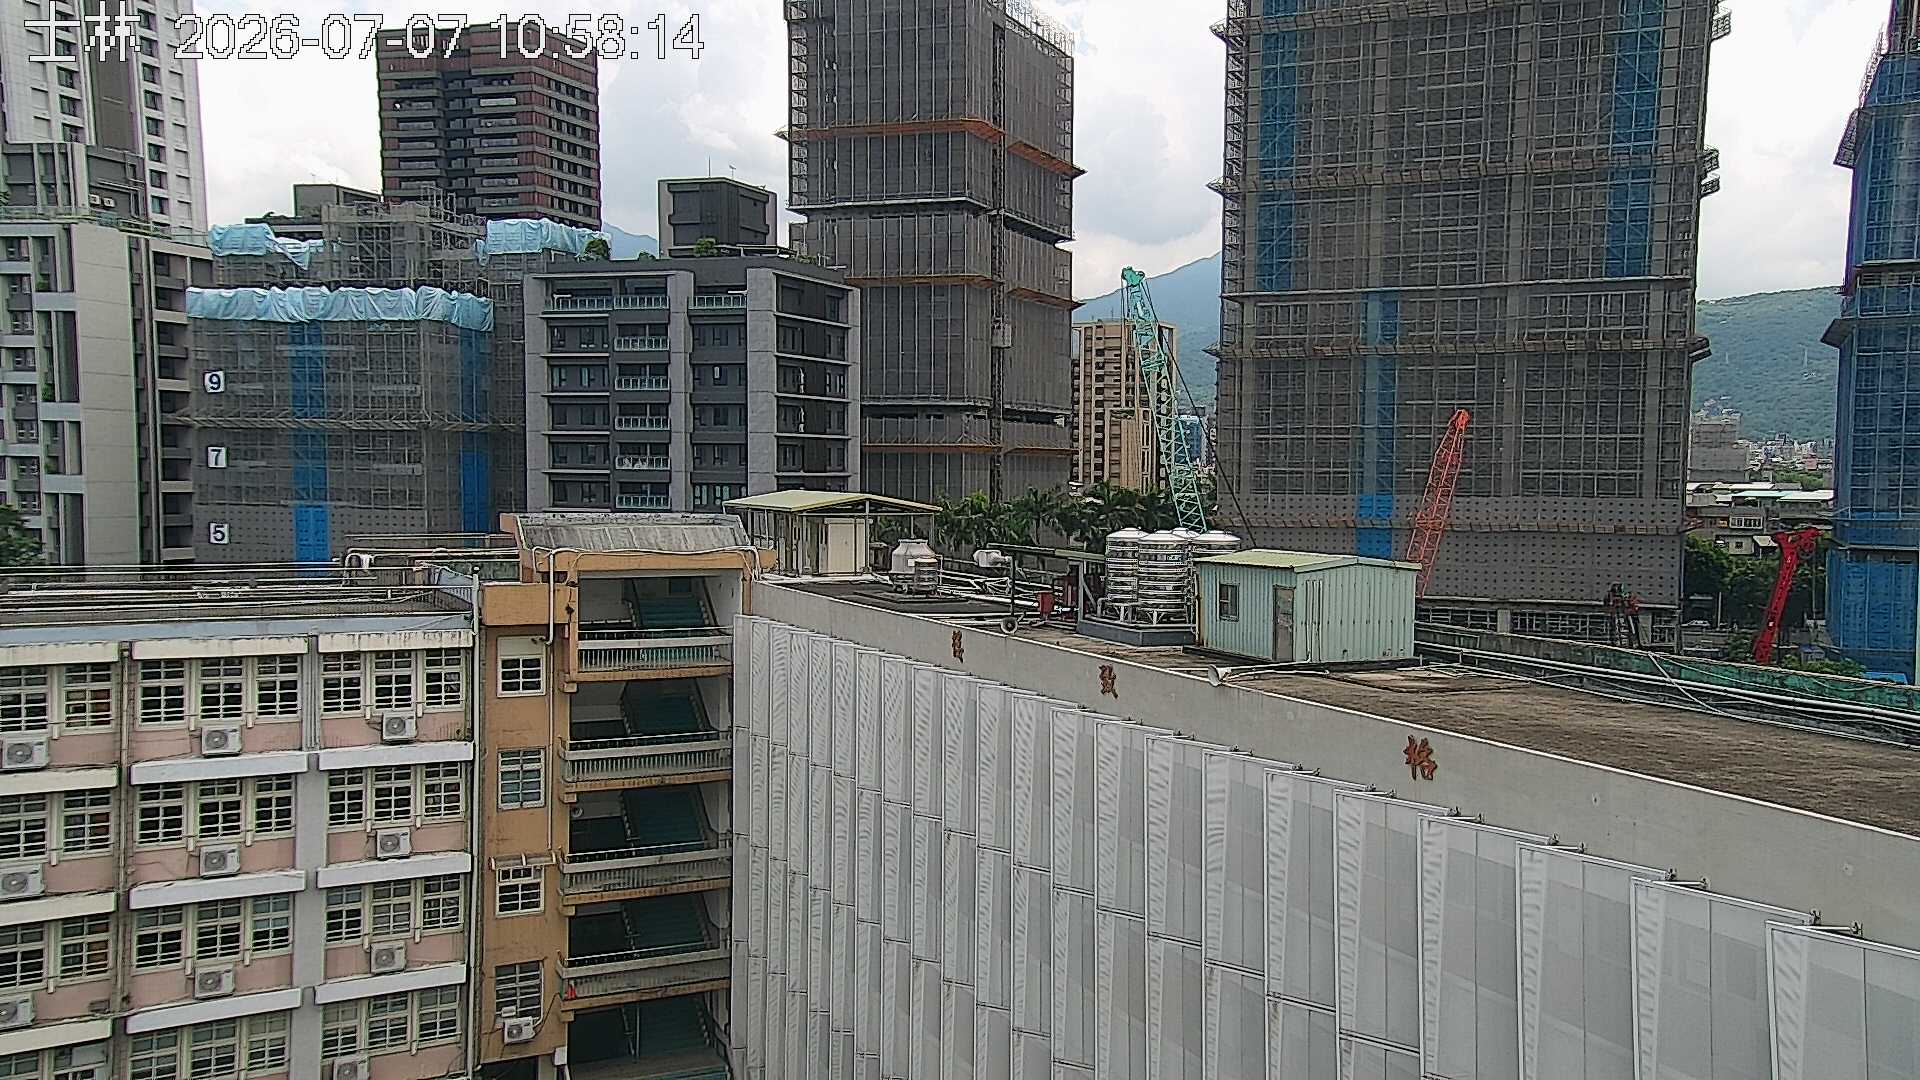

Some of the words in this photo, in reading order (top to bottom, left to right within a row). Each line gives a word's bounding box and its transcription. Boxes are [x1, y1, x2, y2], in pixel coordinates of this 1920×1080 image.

[209, 373, 221, 390] 9
[210, 448, 222, 466] 7
[213, 525, 225, 541] 5
